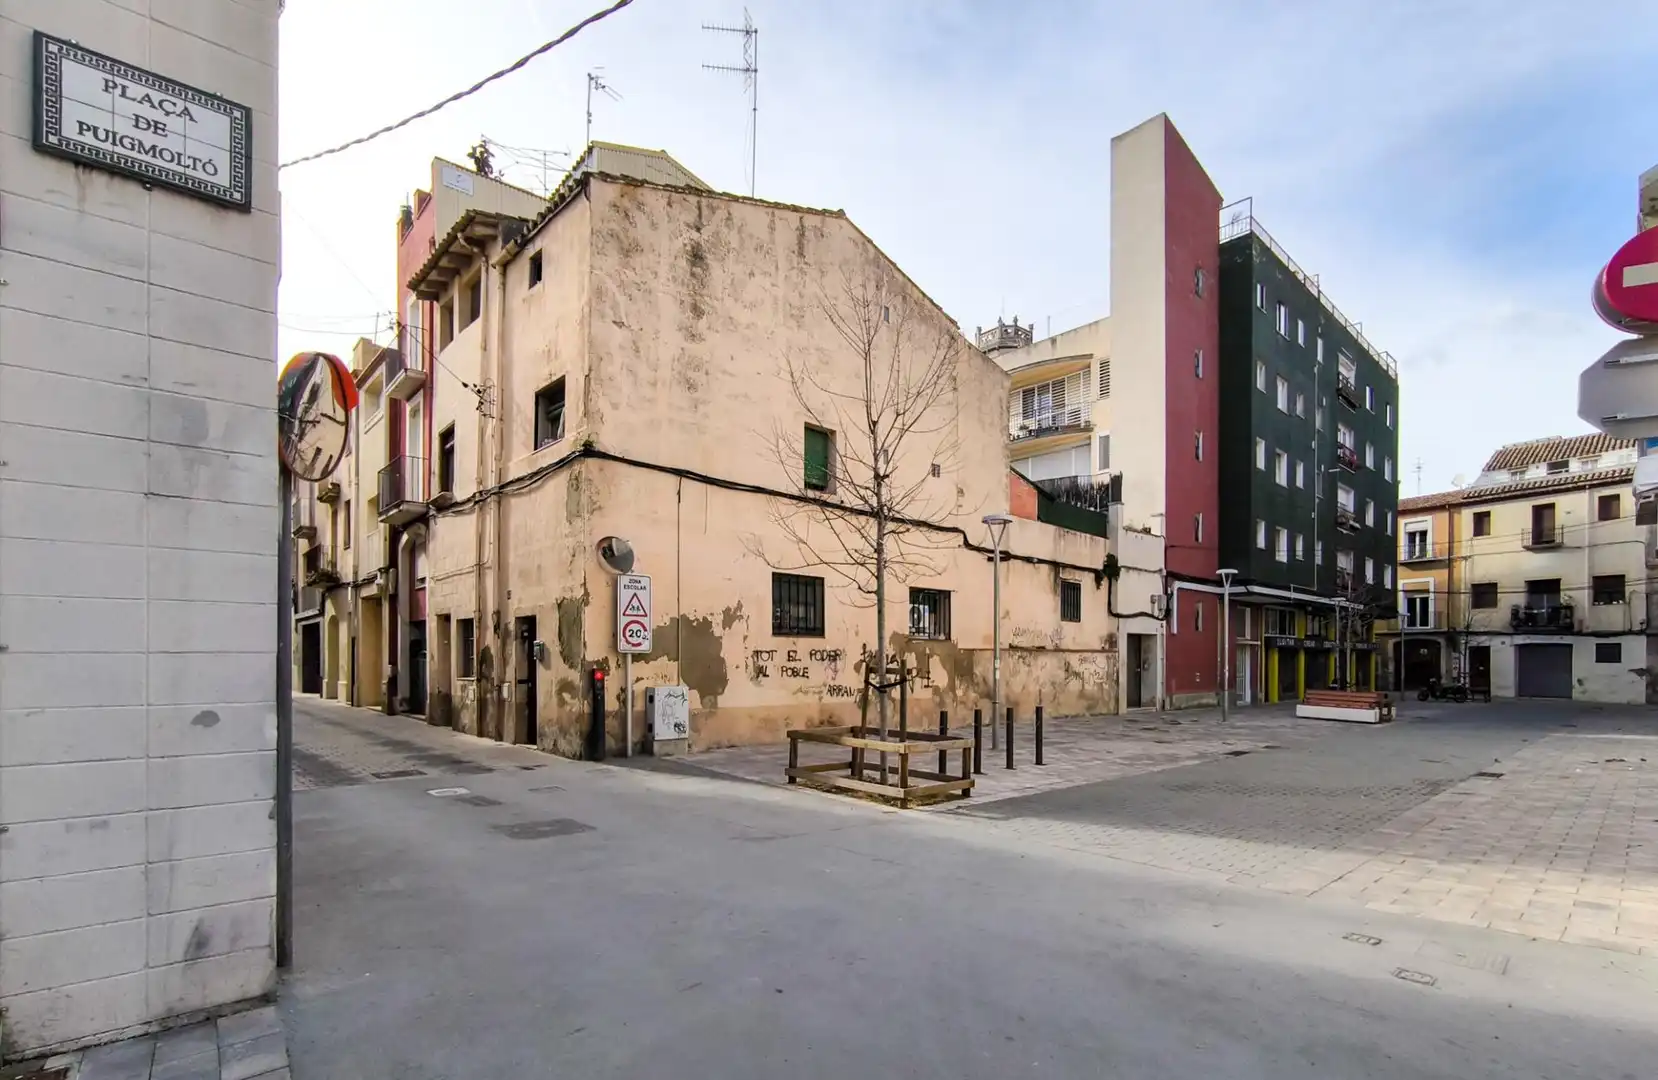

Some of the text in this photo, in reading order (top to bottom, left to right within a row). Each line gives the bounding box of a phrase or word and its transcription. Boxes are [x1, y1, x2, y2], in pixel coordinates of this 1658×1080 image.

[102, 77, 198, 123] PLAÇA
[132, 113, 168, 138] DE
[76, 120, 219, 177] PUIGMOLTÓ
[628, 628, 642, 638] 20
[751, 648, 842, 662] TOT EL PODER
[757, 665, 809, 679] AL POBLE
